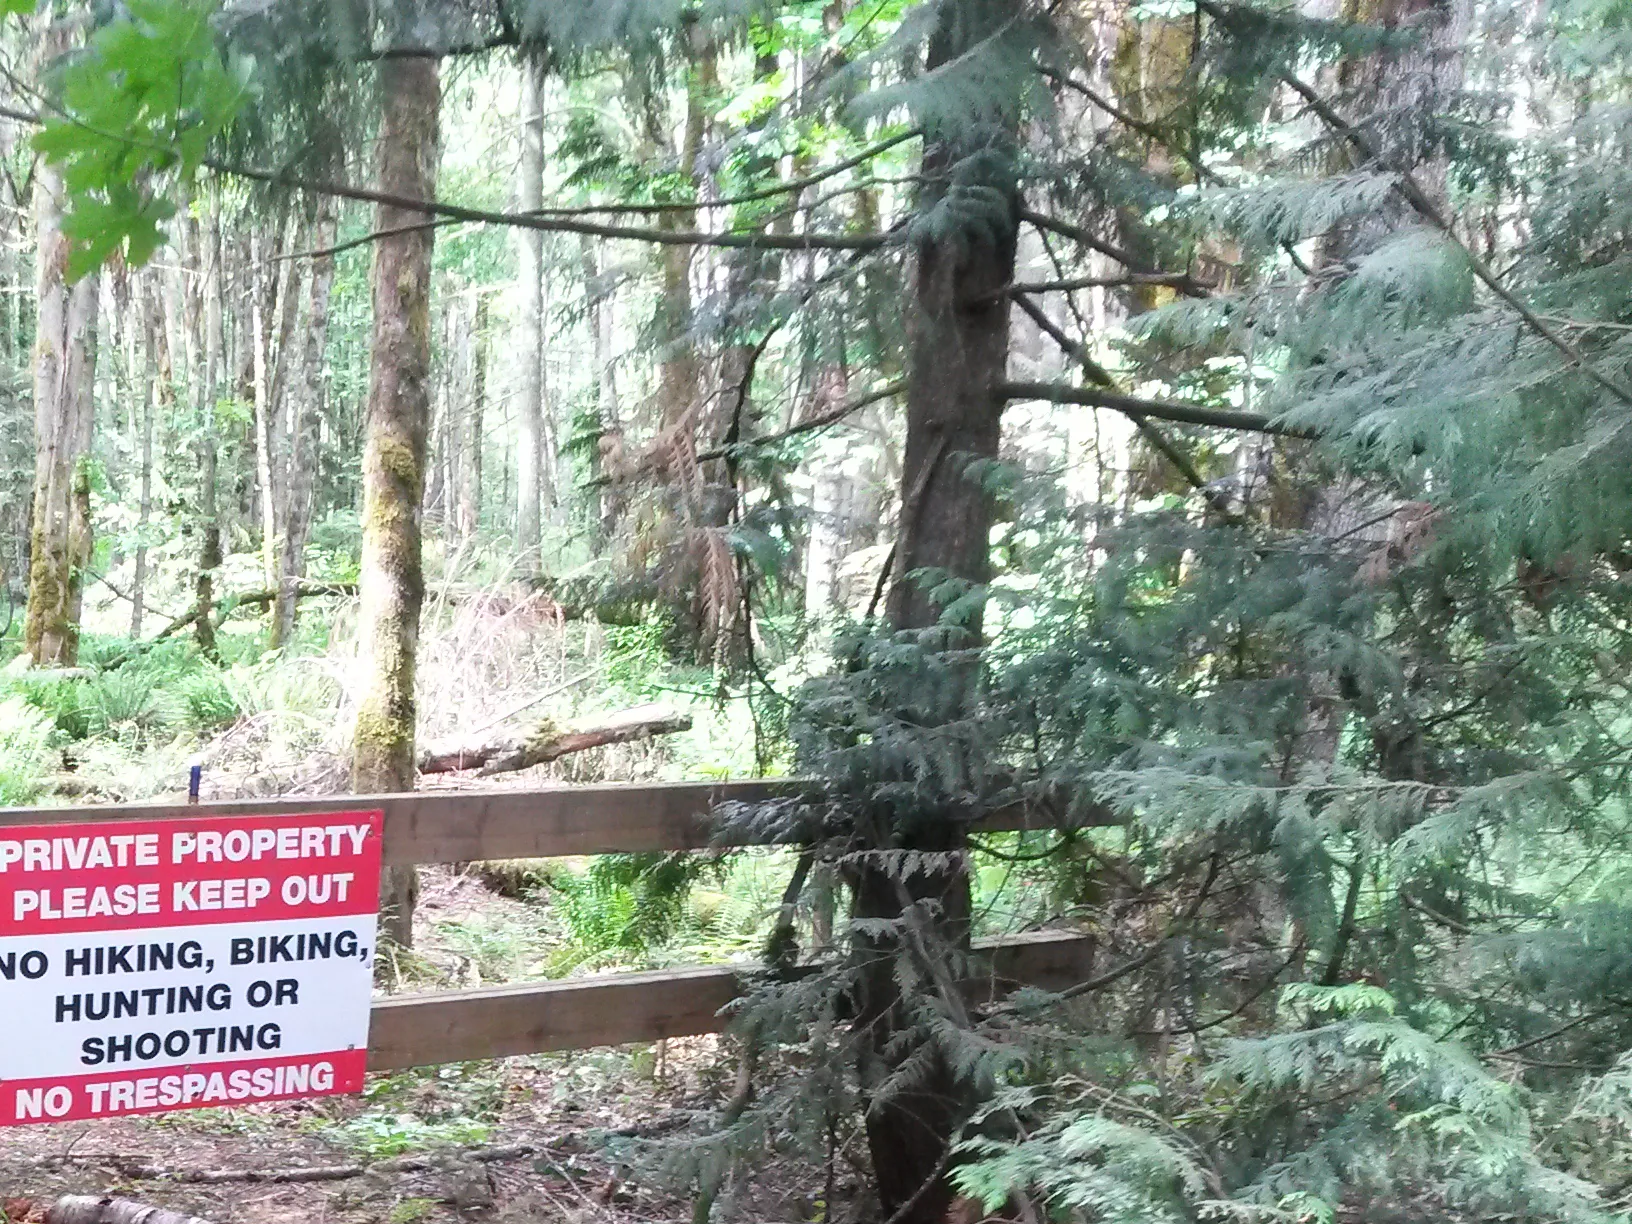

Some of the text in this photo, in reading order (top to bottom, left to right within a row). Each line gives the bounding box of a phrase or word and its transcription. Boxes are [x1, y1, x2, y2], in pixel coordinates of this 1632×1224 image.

[171, 824, 371, 865] PROPERTY
[13, 872, 355, 921] PLEASE KEEP OUT
[65, 940, 215, 977] HIKING,
[230, 930, 369, 966] BIKING,
[55, 978, 299, 1023] HUNTING OR
[80, 1022, 282, 1066] SHOOTING
[15, 1061, 334, 1120] NO TRESPASSING
